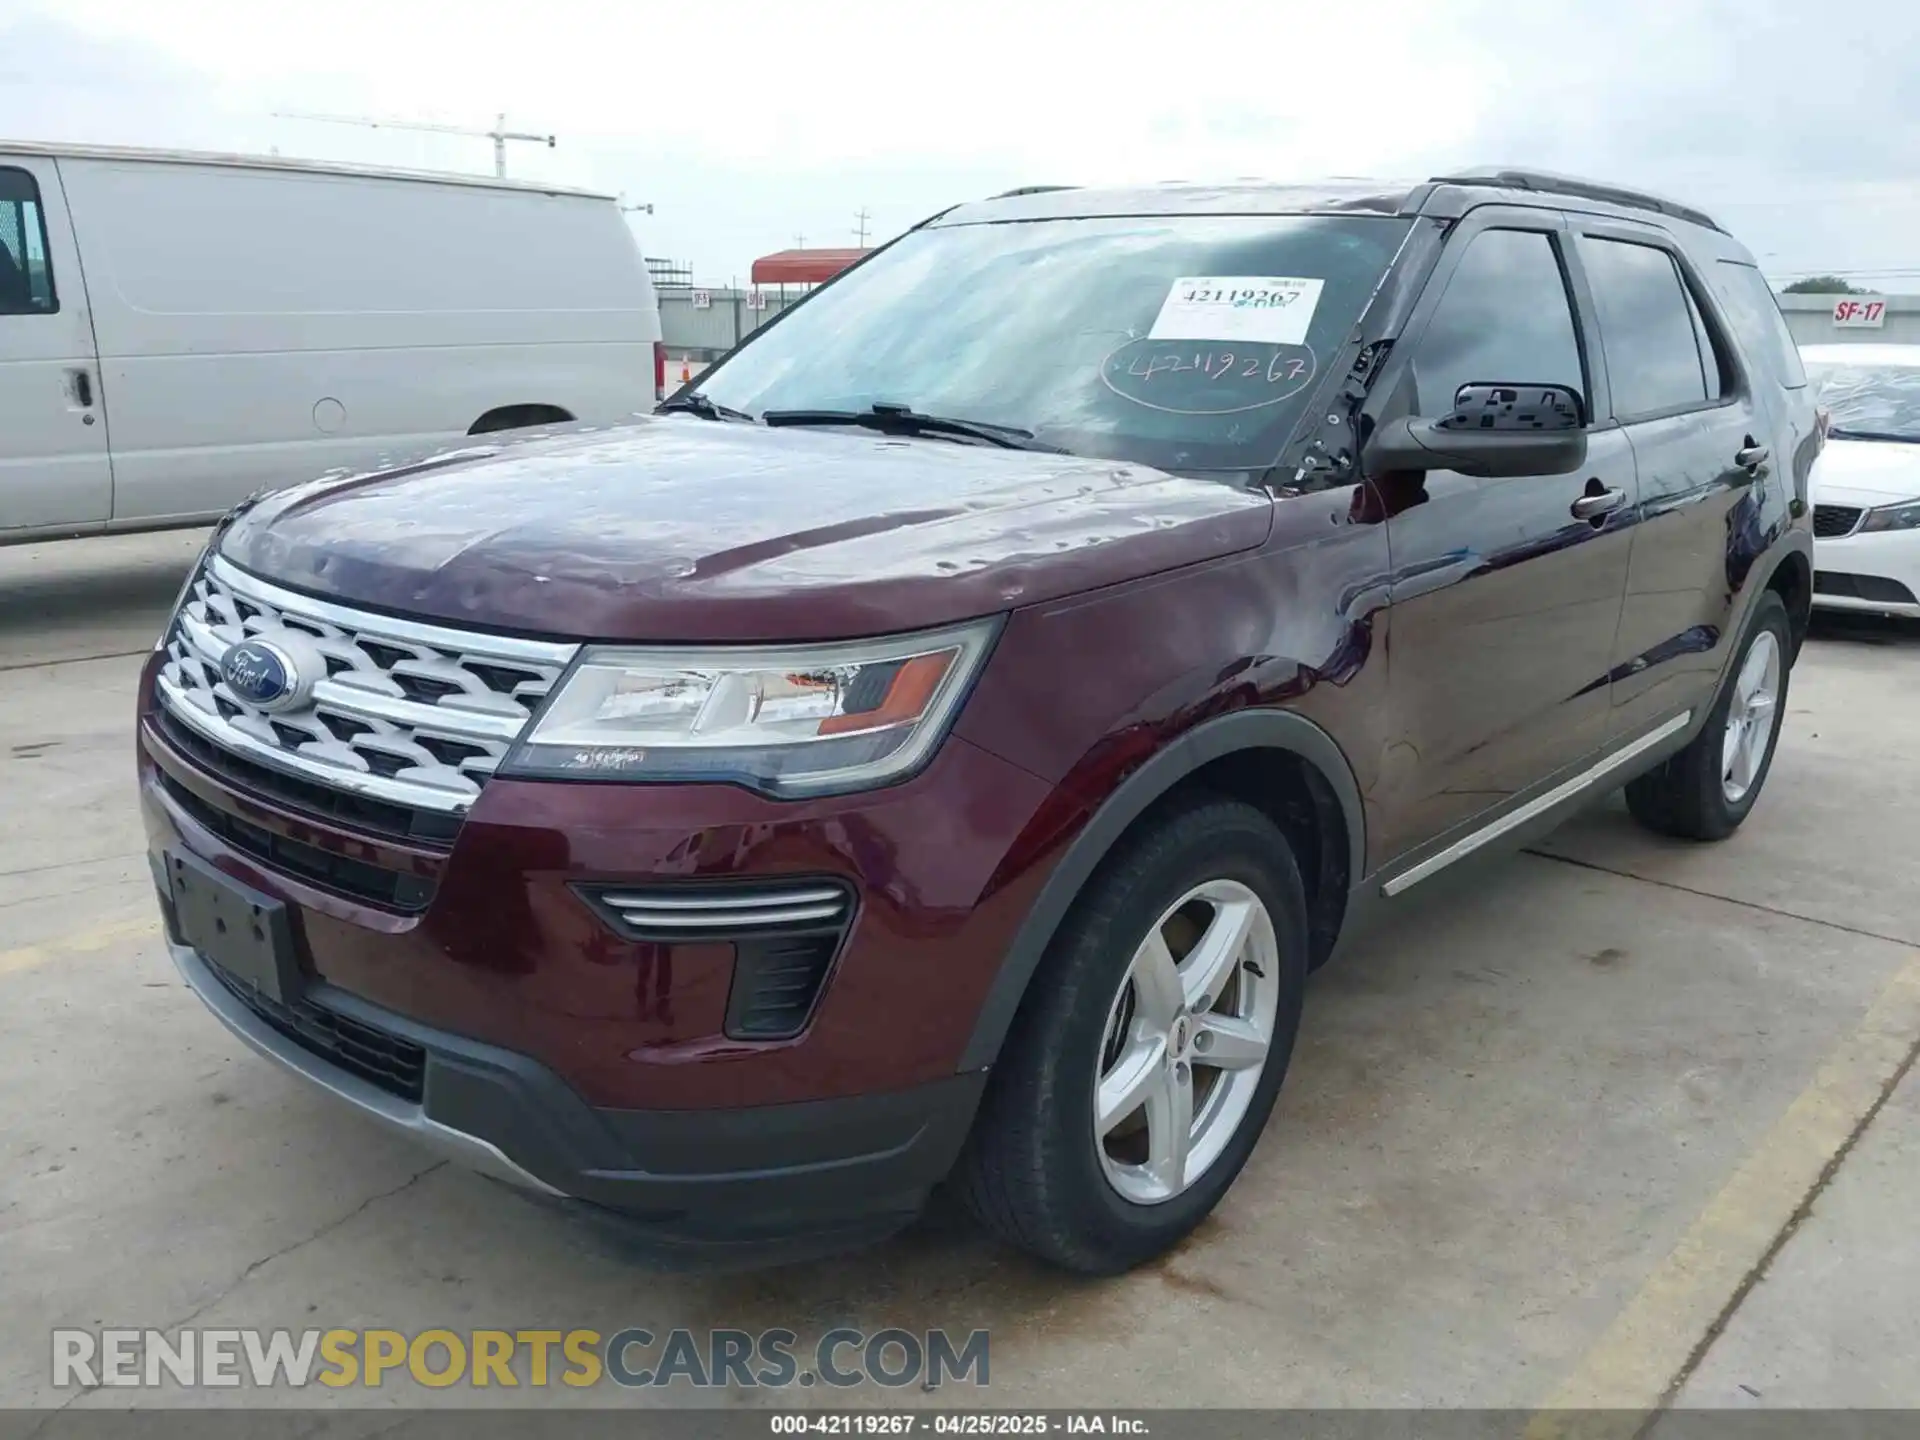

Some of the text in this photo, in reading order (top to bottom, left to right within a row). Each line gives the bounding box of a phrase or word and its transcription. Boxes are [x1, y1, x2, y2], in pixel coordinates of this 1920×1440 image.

[1183, 289, 1301, 305] 42119267
[1834, 301, 1884, 321] SF-17
[1127, 351, 1306, 383] 42119267
[227, 648, 270, 692] Ford
